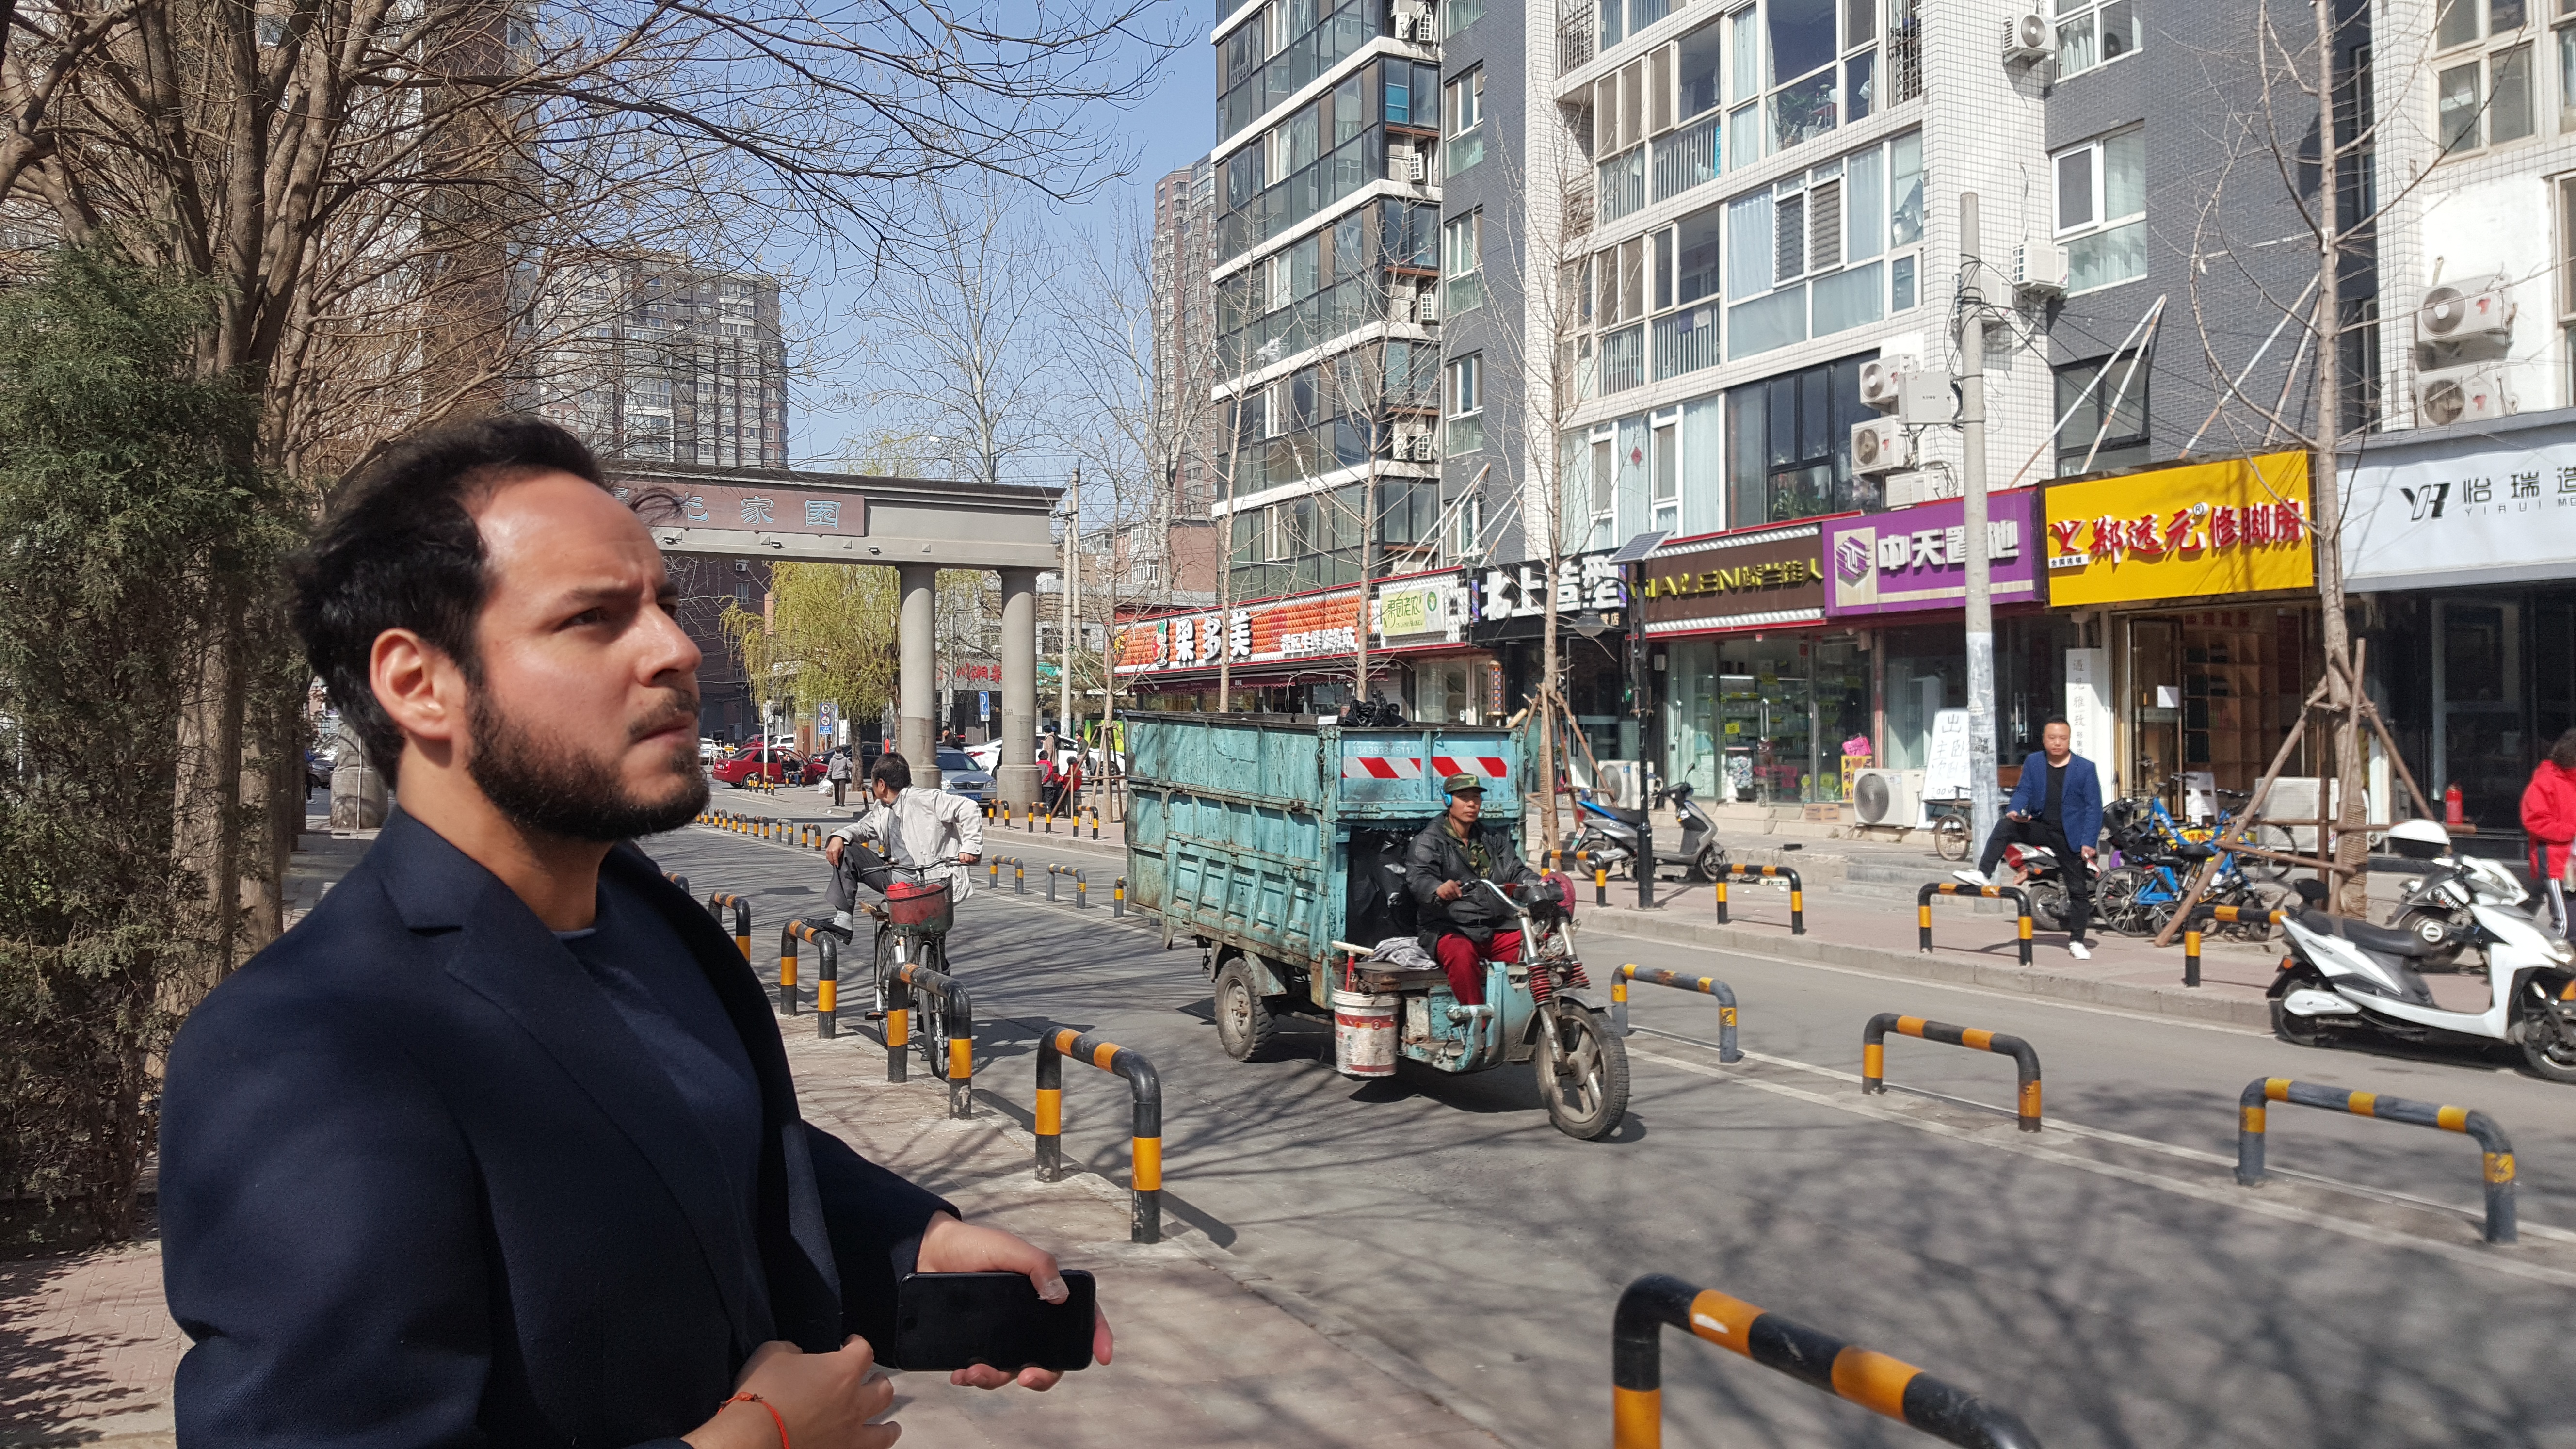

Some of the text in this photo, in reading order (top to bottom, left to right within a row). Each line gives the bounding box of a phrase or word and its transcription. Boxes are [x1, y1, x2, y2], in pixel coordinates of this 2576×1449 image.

[610, 487, 841, 530] 光家园
[1878, 520, 2019, 570] 中天置地
[1175, 610, 1250, 661] 果多美
